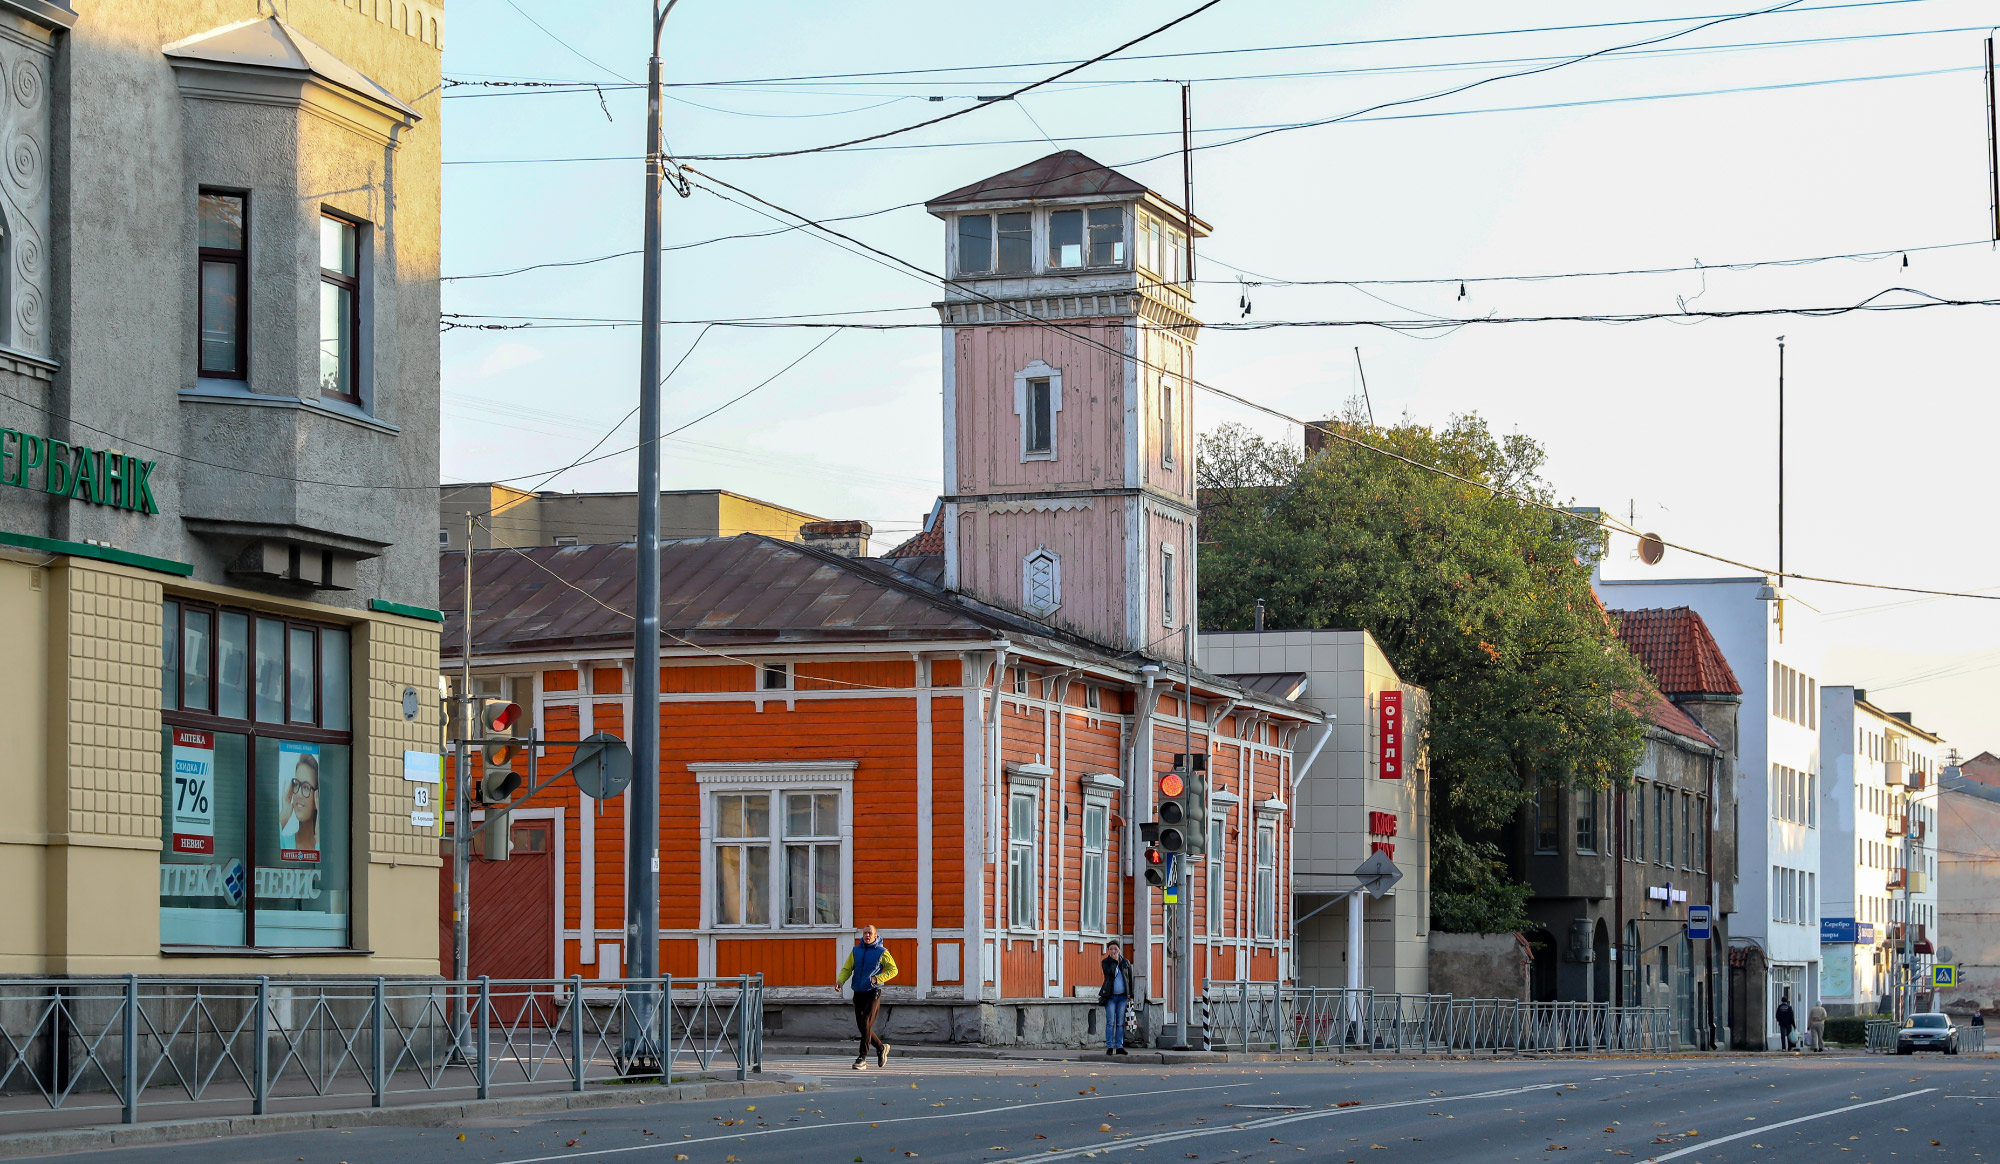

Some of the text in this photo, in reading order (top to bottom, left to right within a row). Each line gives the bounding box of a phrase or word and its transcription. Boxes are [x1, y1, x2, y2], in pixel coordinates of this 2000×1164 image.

[180, 733, 206, 744] АПТЕКА
[1384, 705, 1396, 772] ОТЕЛЬ
[177, 761, 198, 772] СКИДКА
[175, 778, 208, 813] 7%
[418, 790, 427, 803] 13
[1372, 812, 1397, 836] КАФЕ
[181, 838, 205, 849] НЕВИС
[255, 868, 321, 899] НЕВИС
